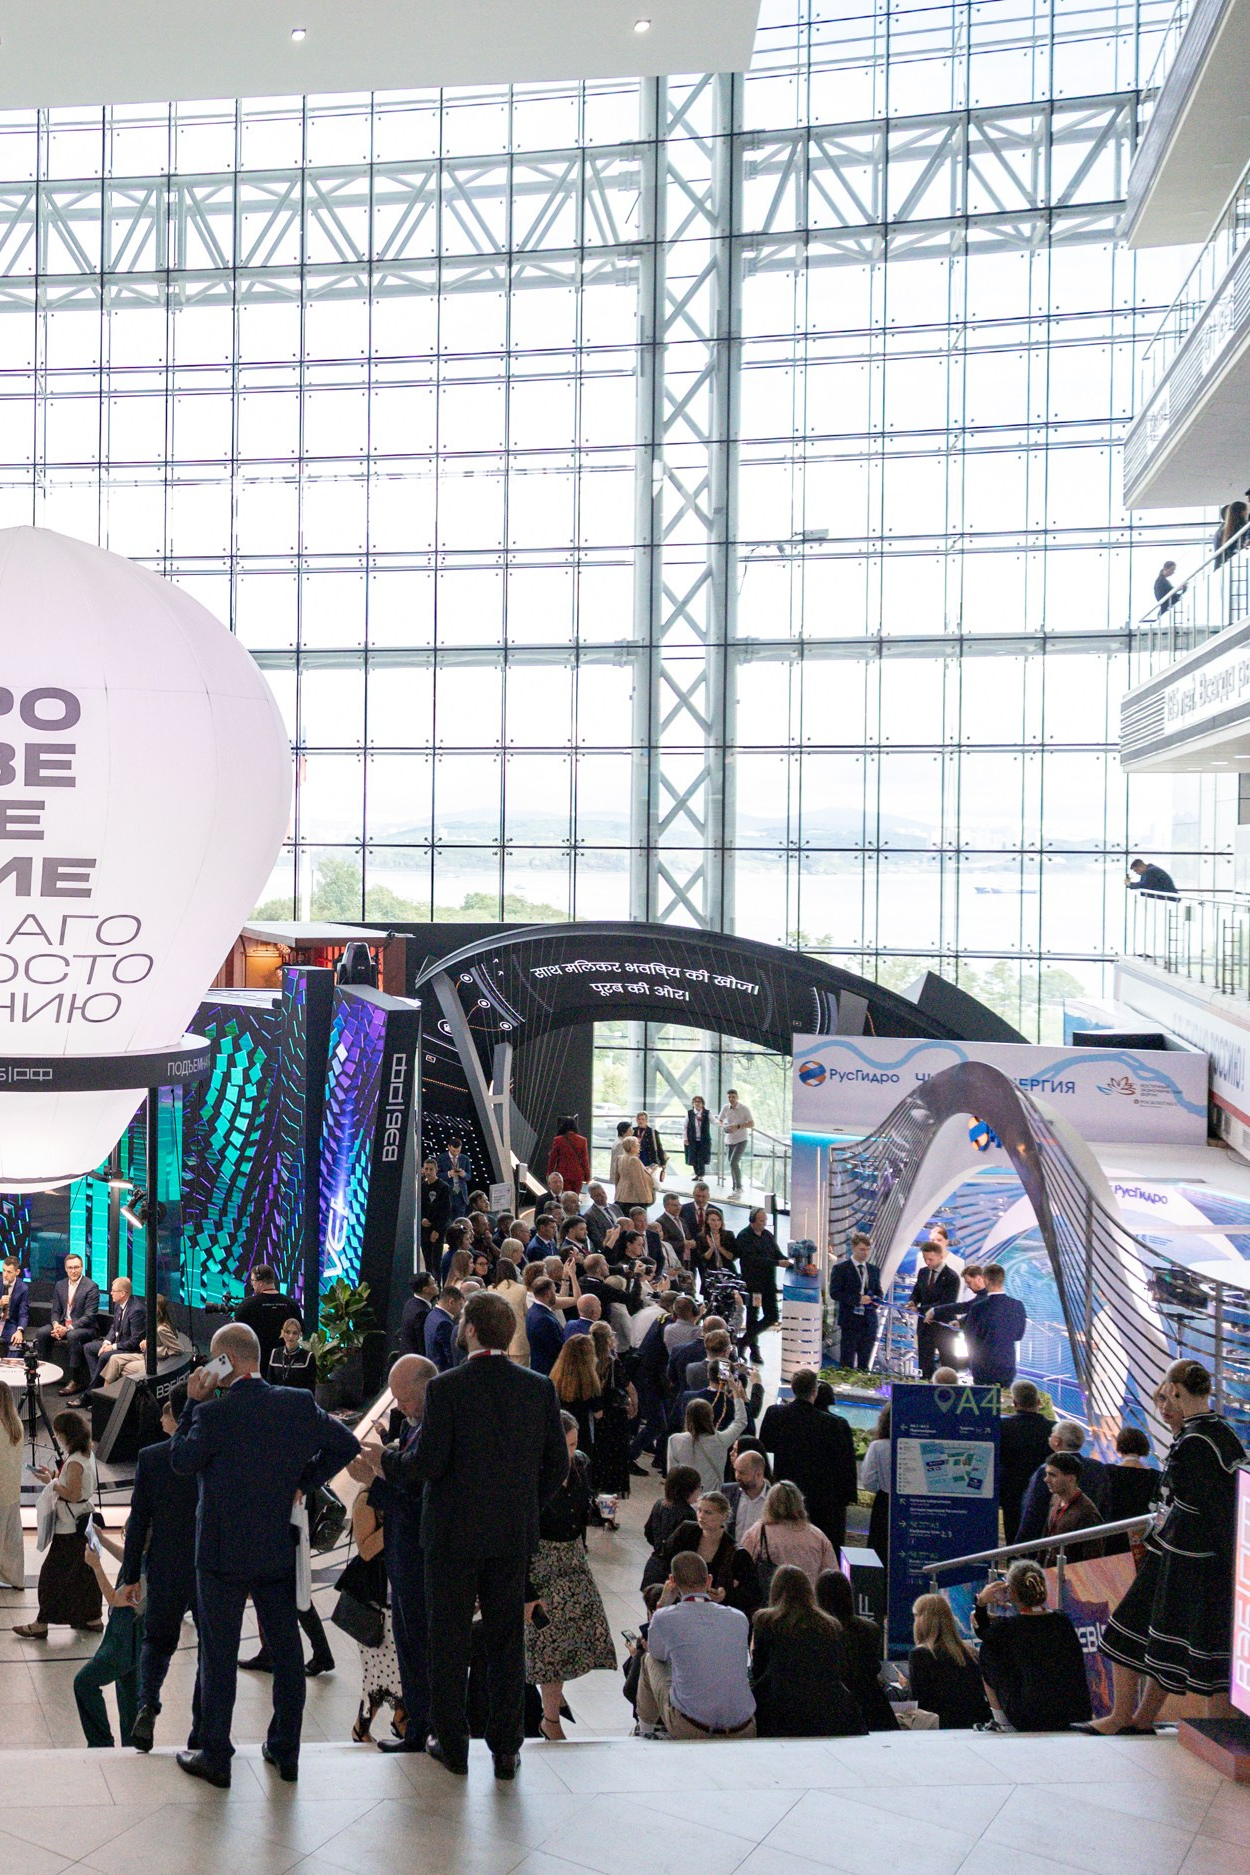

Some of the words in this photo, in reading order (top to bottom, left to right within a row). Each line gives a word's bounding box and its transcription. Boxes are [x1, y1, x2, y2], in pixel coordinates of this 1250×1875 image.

[684, 969, 710, 982] की
[624, 981, 649, 994] की
[829, 1069, 900, 1084] РусГидро
[1014, 1078, 1076, 1094] ЕРГИЯ
[382, 1054, 407, 1161] ВЭБ|РФ
[1114, 1185, 1167, 1205] РусГидро
[956, 1387, 1000, 1416] A4
